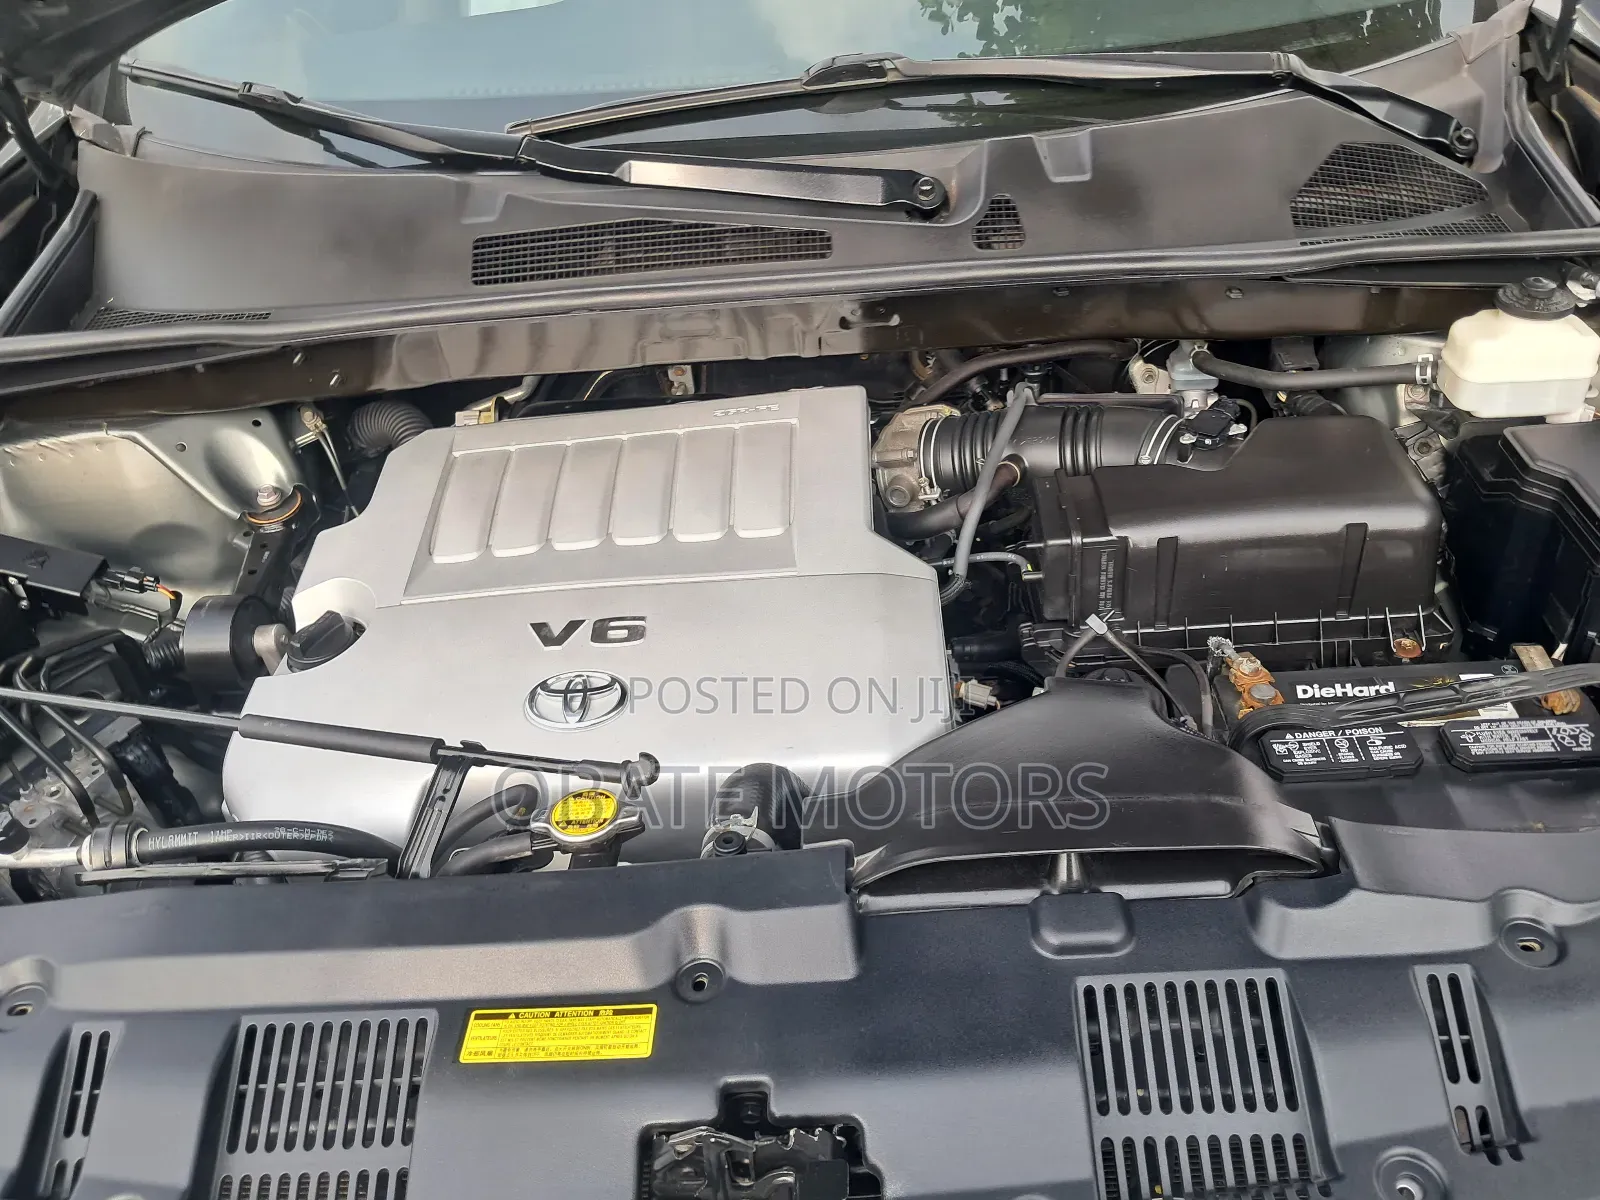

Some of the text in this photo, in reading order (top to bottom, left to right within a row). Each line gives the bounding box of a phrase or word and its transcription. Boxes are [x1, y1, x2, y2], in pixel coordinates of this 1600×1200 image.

[529, 616, 647, 650] V6
[1296, 681, 1395, 699] DieHard
[1294, 730, 1336, 739] DANGER
[1345, 727, 1383, 735] POISON
[518, 1010, 594, 1019] CAUTION ATTENTION
